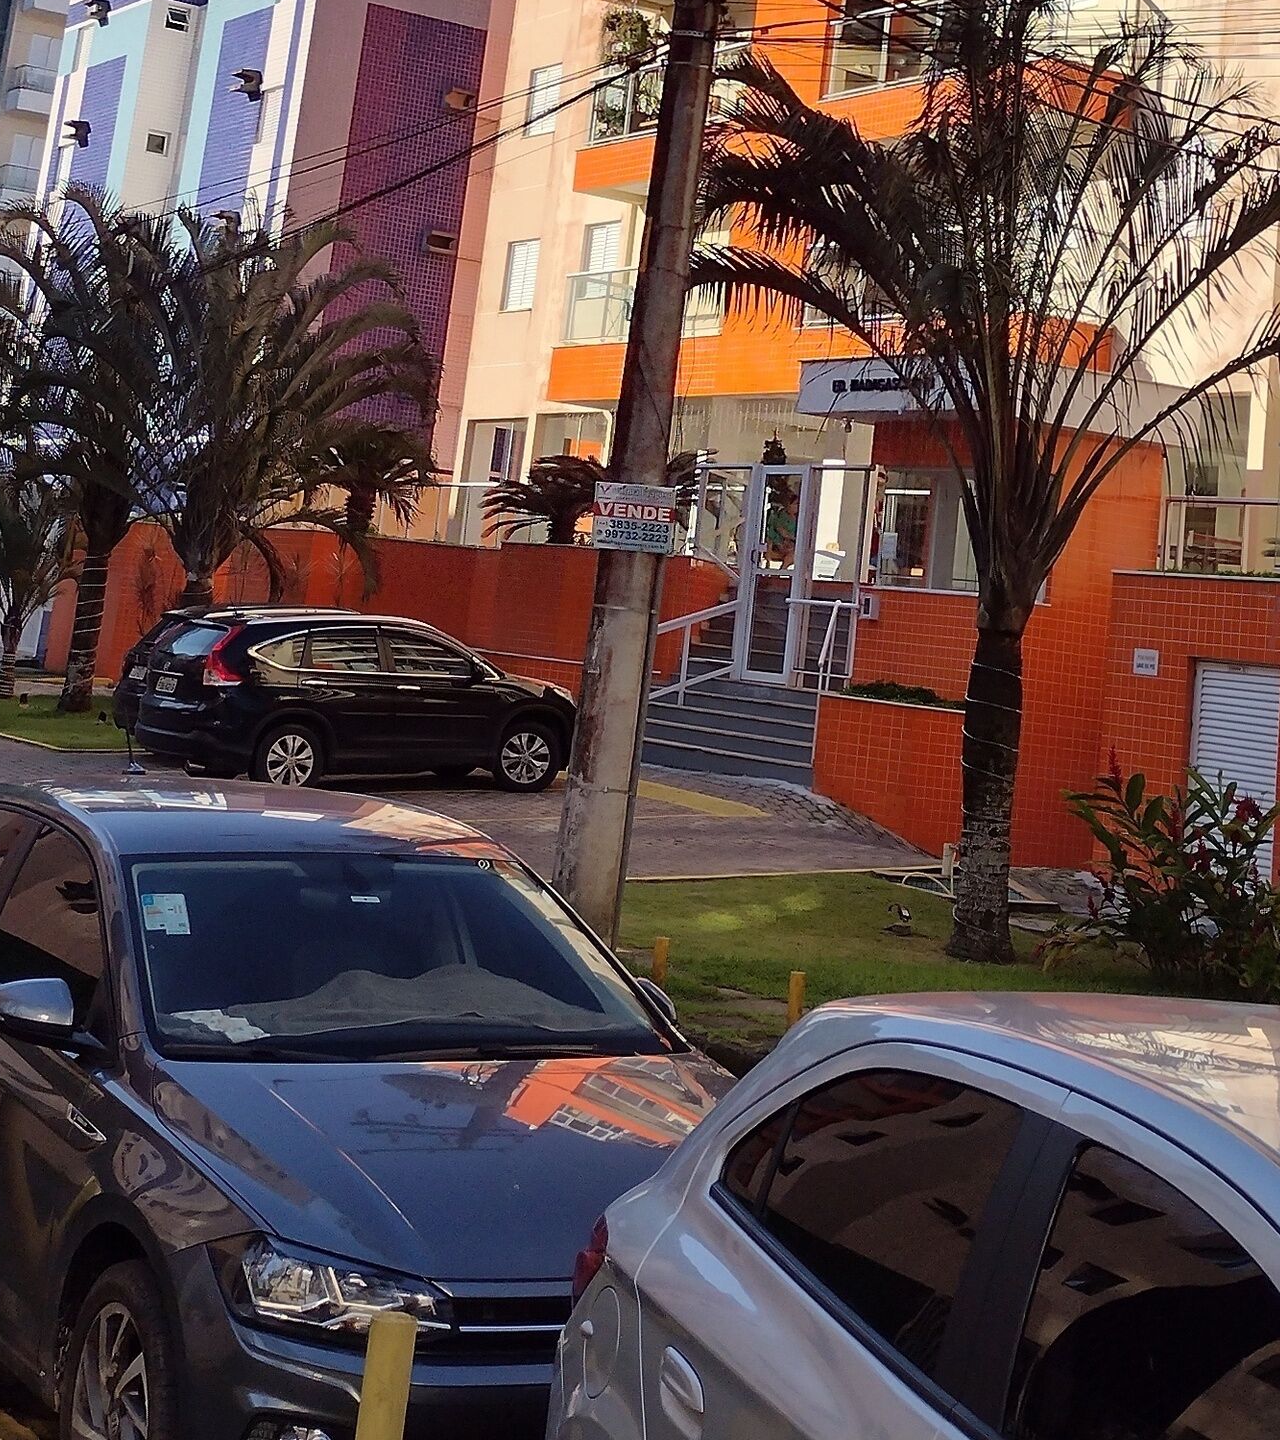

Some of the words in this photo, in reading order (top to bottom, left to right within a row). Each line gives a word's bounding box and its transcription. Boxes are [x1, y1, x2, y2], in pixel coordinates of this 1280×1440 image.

[598, 502, 671, 522] VENDE
[609, 520, 669, 534] 3835-2223
[605, 529, 669, 544] 99732-2223
